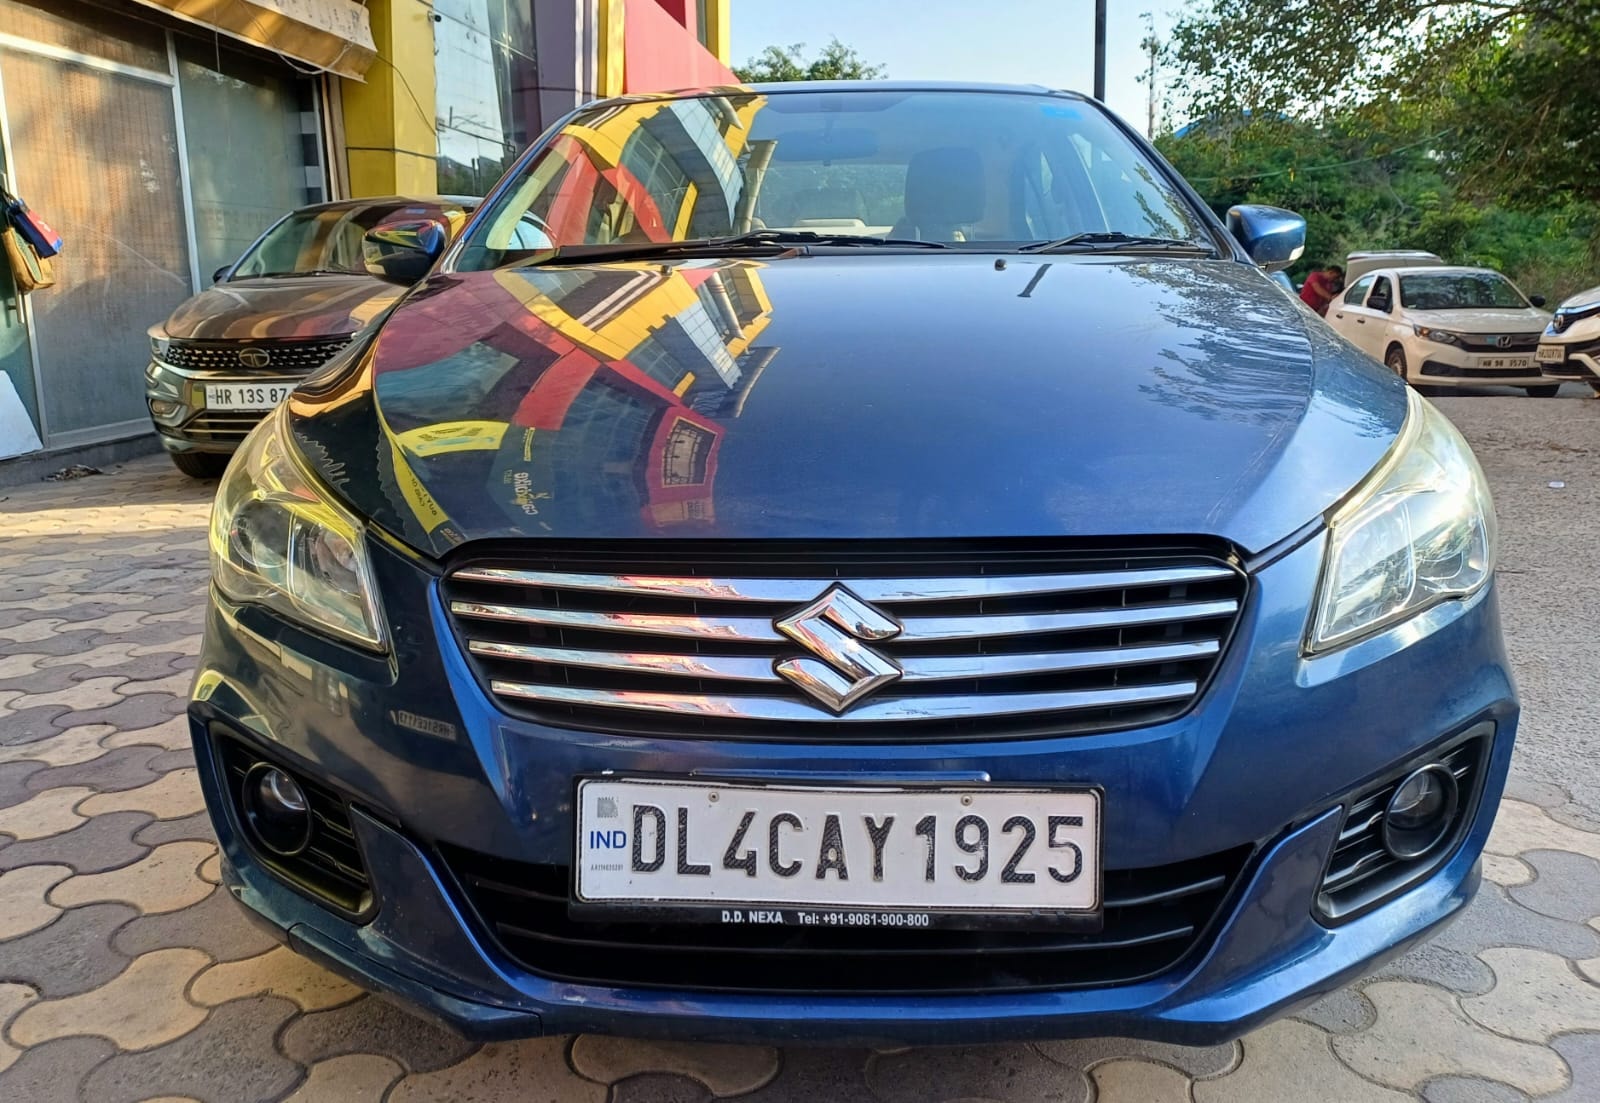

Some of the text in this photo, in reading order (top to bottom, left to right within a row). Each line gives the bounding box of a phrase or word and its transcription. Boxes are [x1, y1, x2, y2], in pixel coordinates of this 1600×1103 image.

[215, 388, 232, 404] HR
[238, 388, 264, 404] 13S
[590, 830, 627, 850] IND
[632, 804, 1083, 883] DL4CAY1925
[722, 910, 929, 927] D.D. NEXA Tel: +91-9081-900-800
